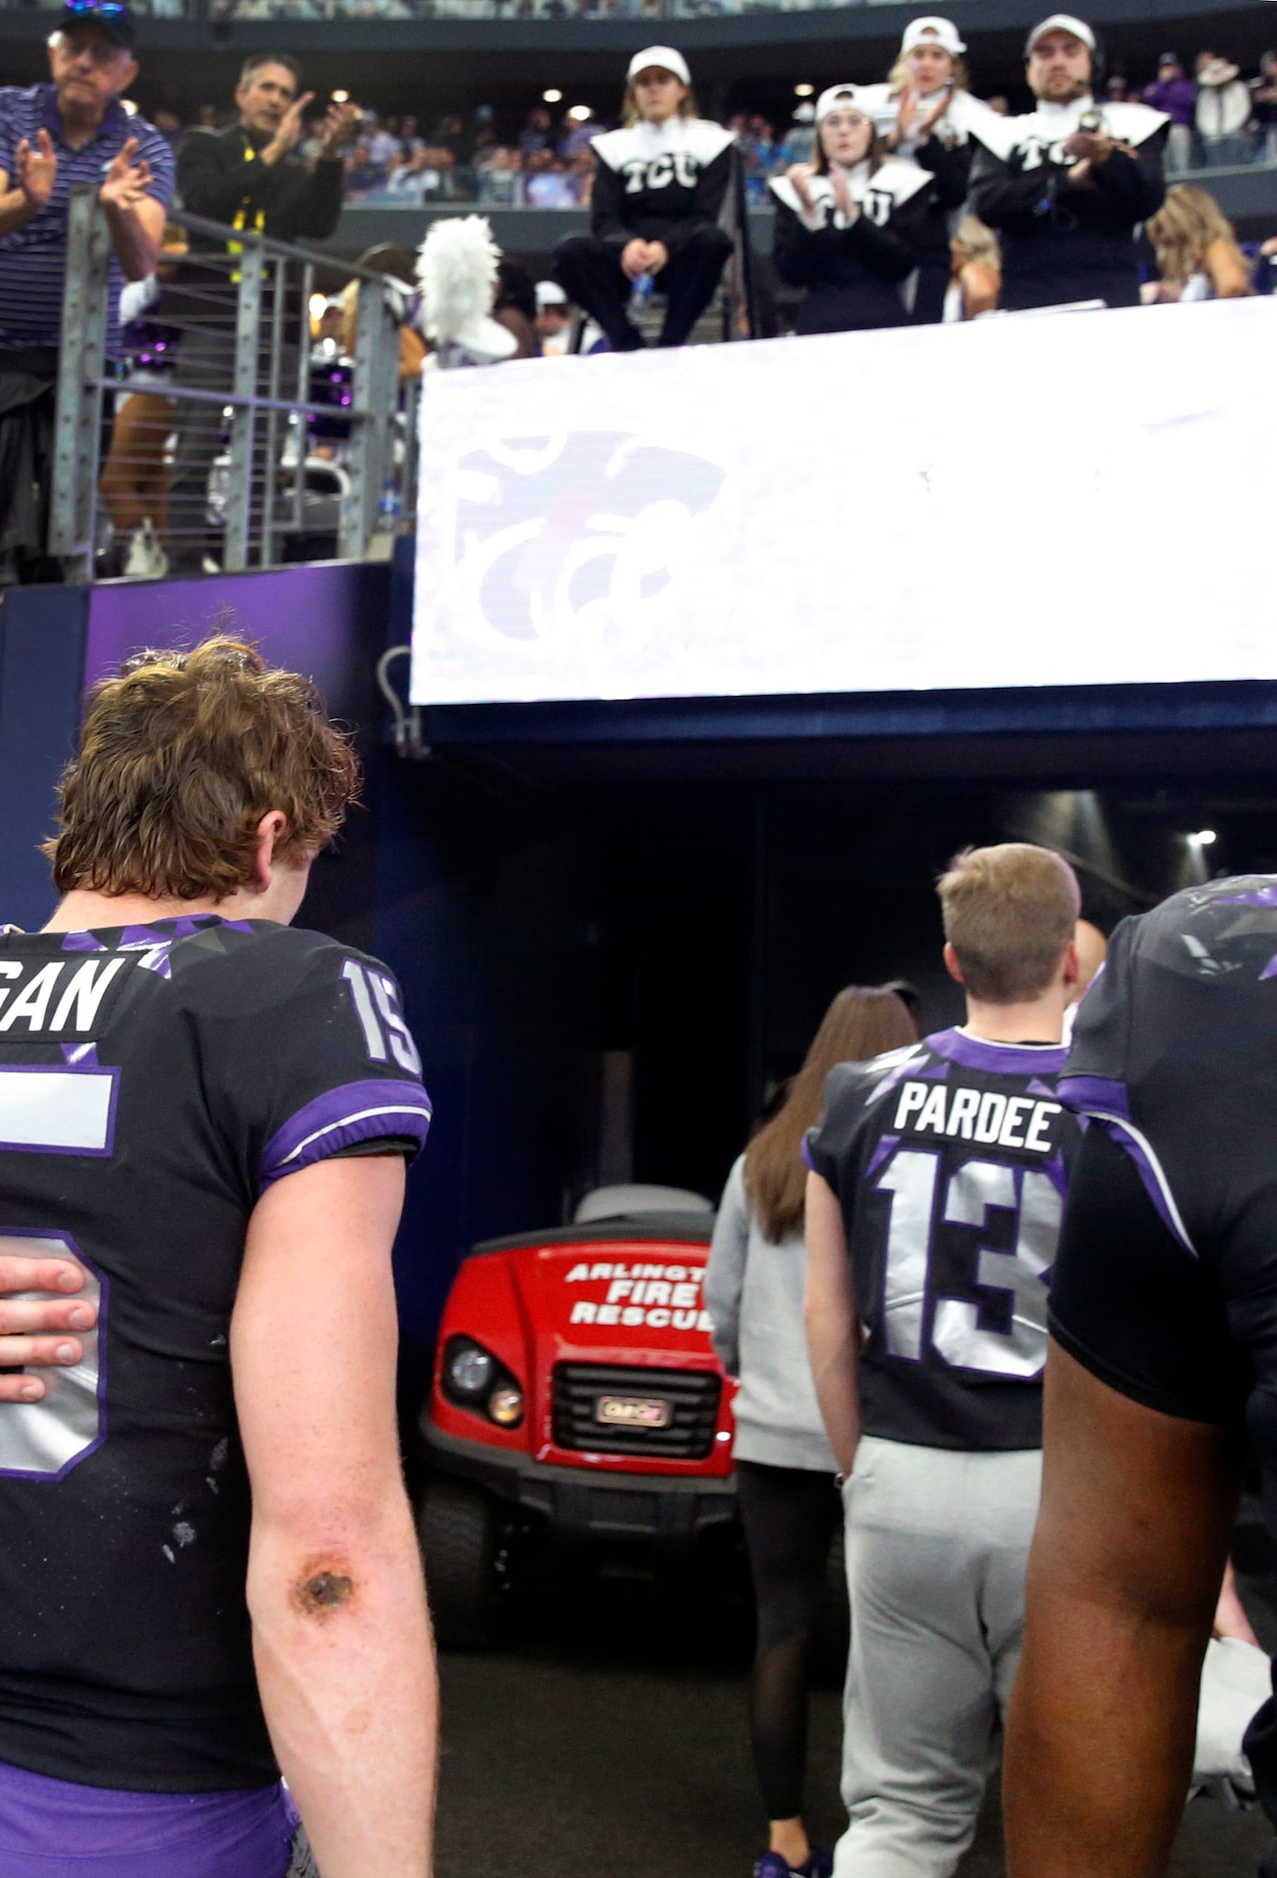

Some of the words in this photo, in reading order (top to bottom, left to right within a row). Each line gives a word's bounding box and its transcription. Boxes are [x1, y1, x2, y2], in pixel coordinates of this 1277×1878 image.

[624, 152, 699, 194] TCU
[339, 956, 422, 1078] 15
[894, 1081, 1063, 1152] PARDEE
[565, 1262, 707, 1283] ARLINGT
[874, 1147, 1068, 1381] 13
[606, 1279, 700, 1308] FIRE
